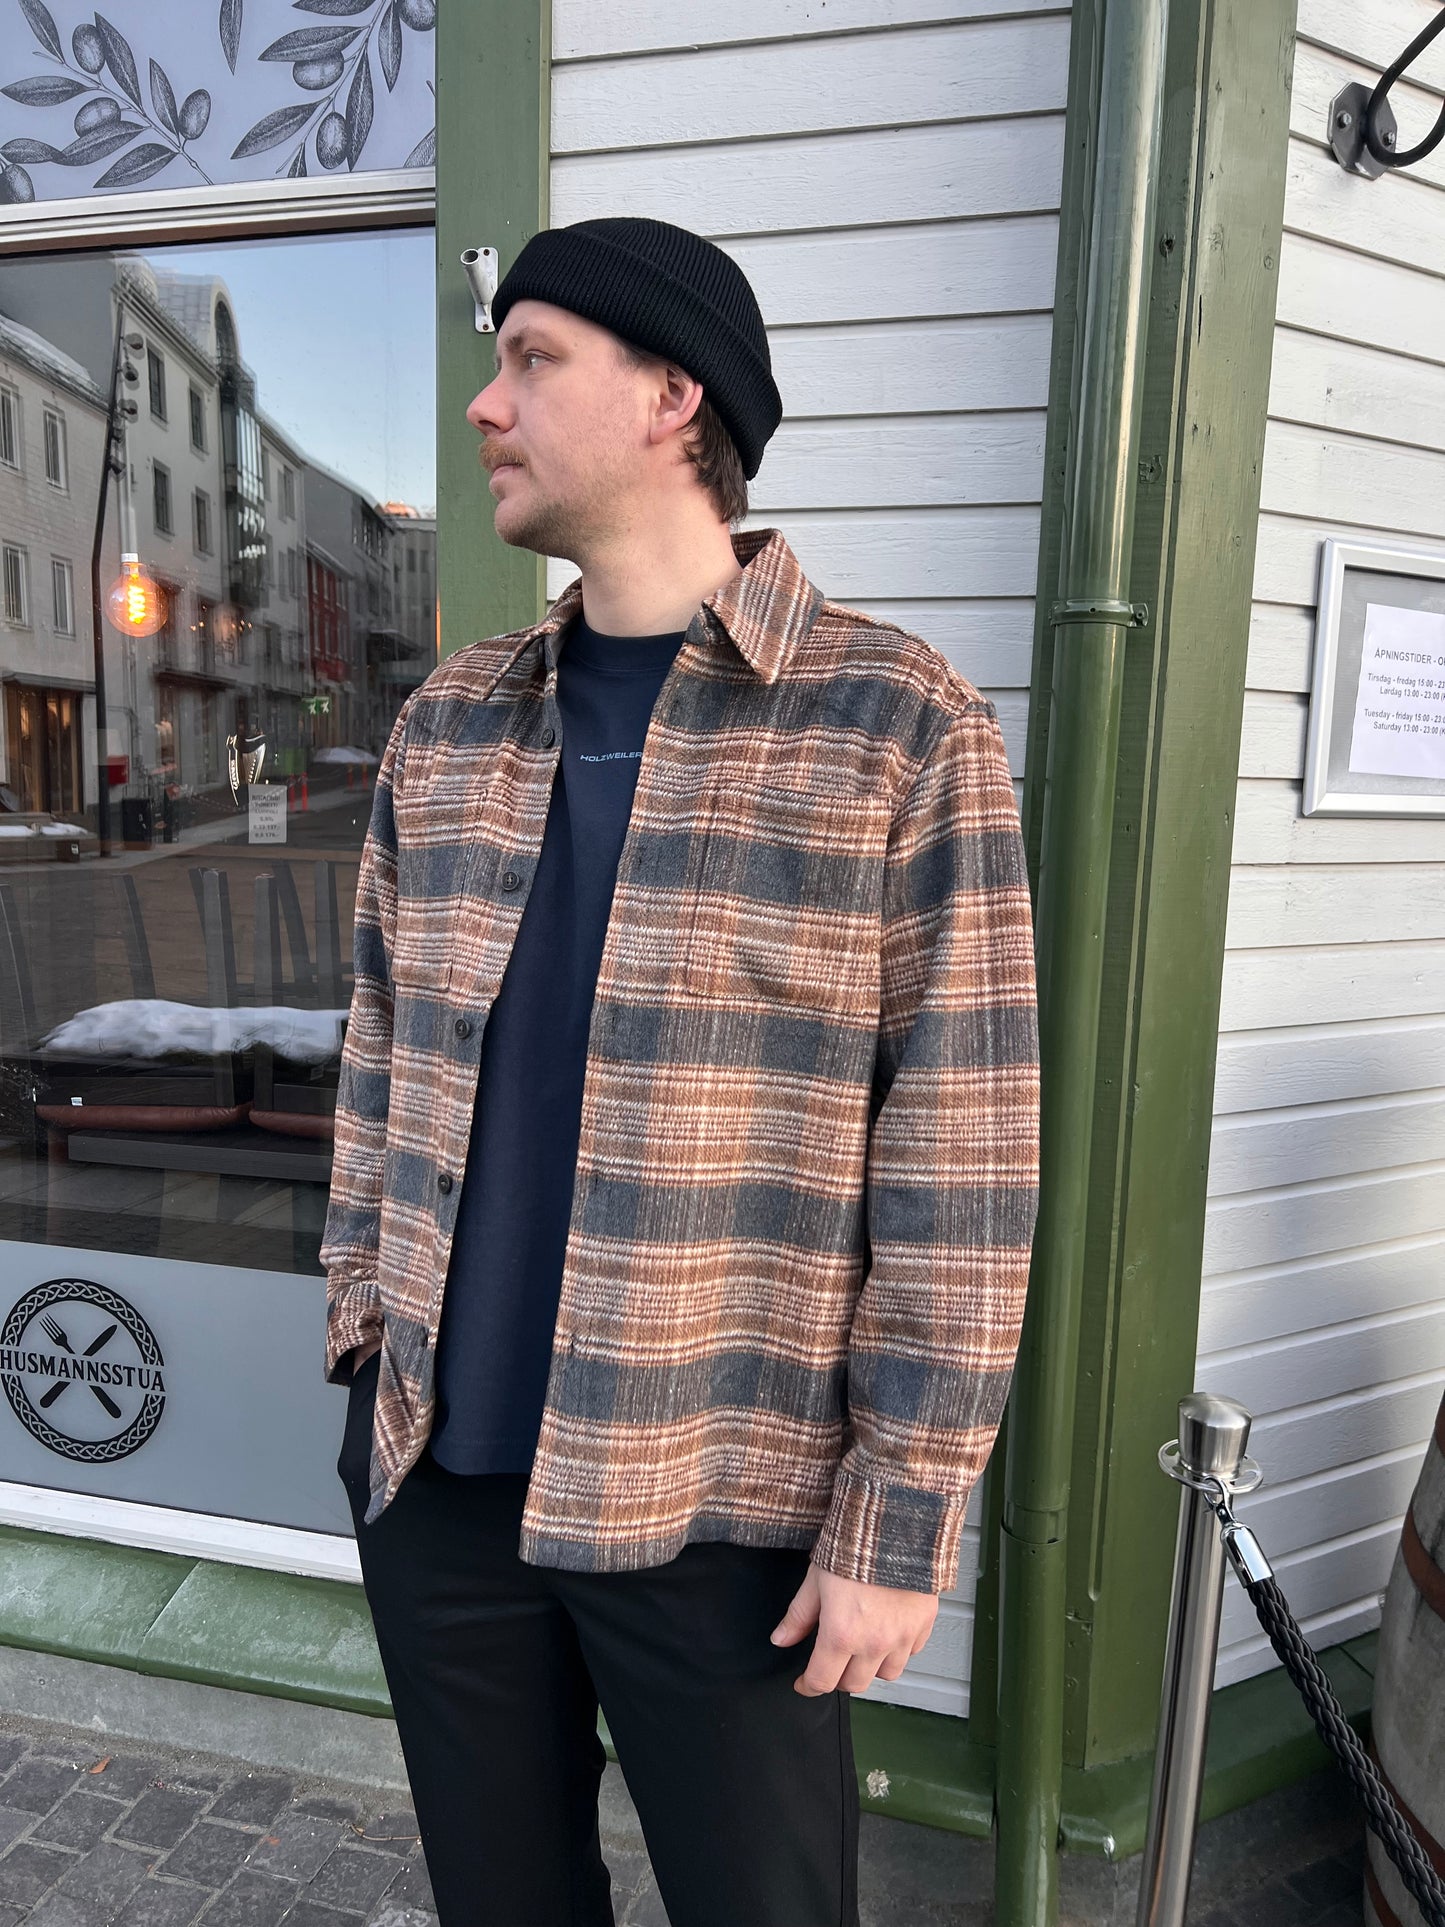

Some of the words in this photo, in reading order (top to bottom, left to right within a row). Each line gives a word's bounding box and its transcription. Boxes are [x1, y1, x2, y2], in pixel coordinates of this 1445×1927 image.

[1374, 647, 1432, 664] ÅPNINGSTIDER
[1368, 672, 1391, 685] Tirsdag
[1396, 676, 1416, 688] fredag
[1380, 686, 1402, 698] Lørdag
[1364, 708, 1390, 720] Tuesday
[1396, 711, 1413, 722] friday
[1373, 721, 1401, 733] Saturday
[580, 751, 643, 762] HOLZWEILER
[0, 1349, 166, 1392] HUSMANNSSTUA
